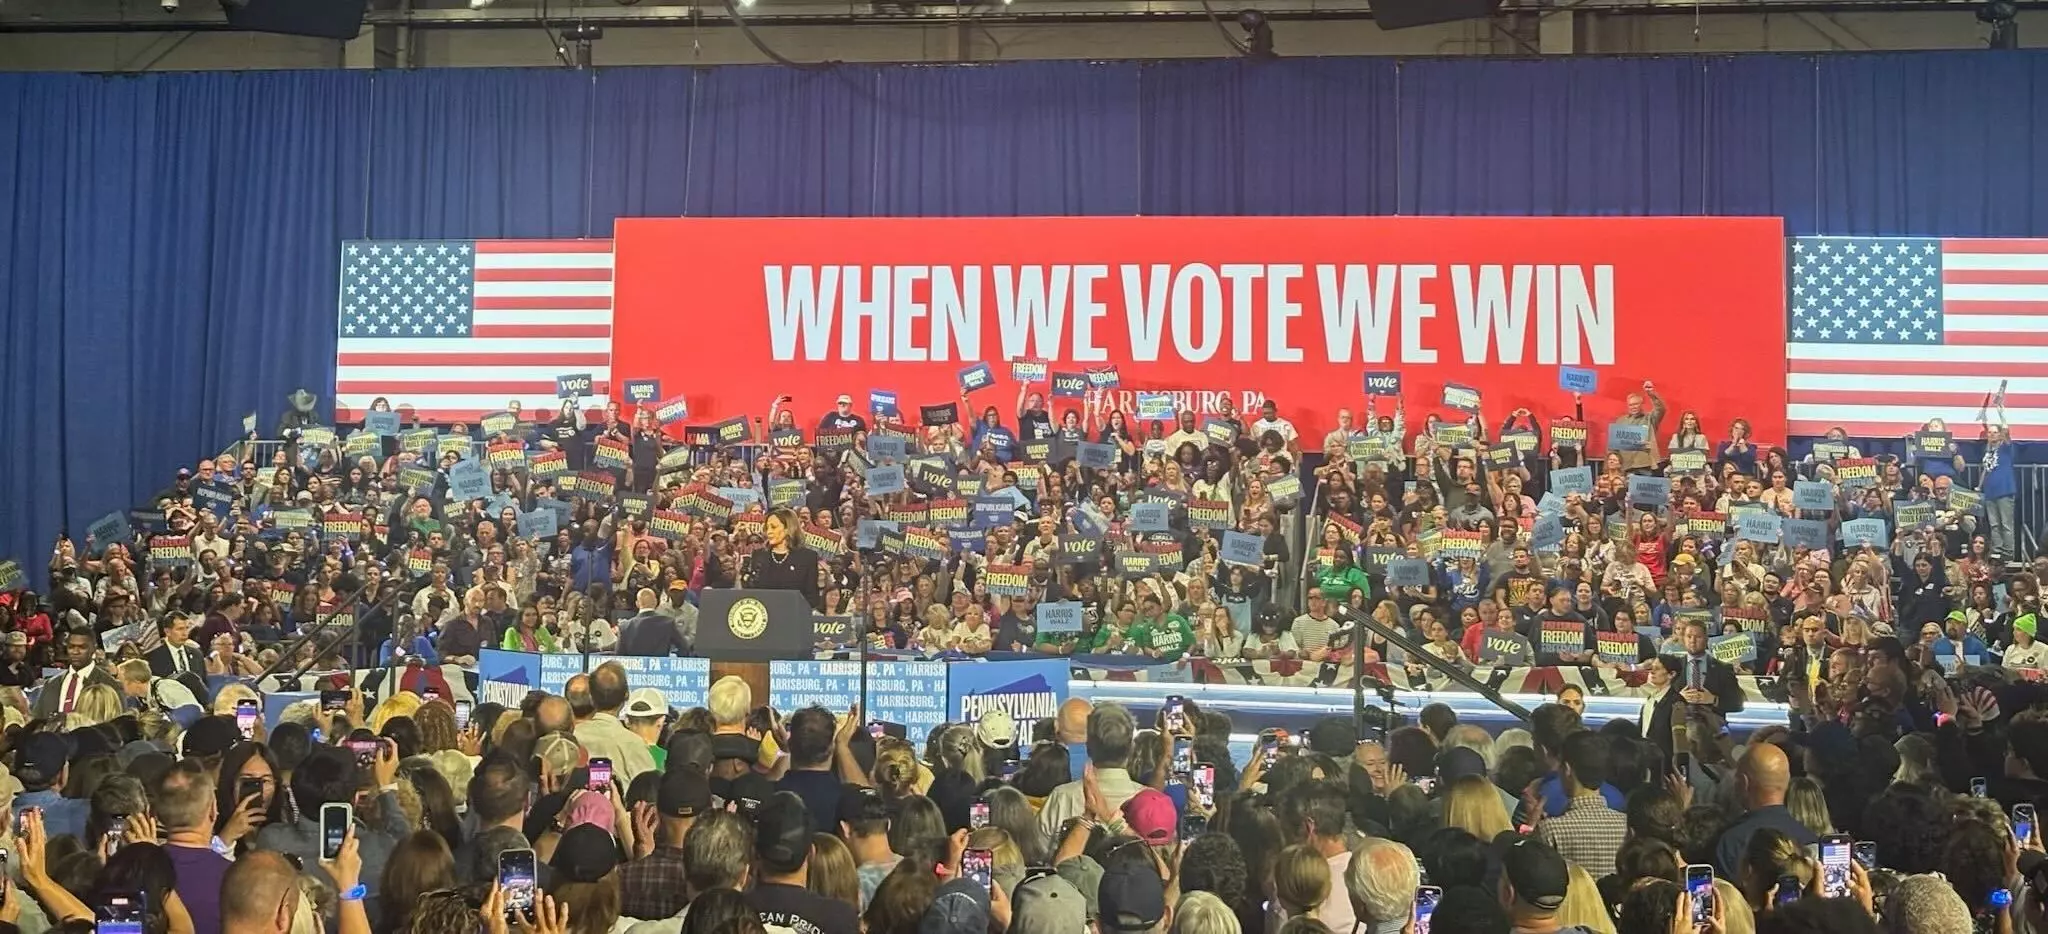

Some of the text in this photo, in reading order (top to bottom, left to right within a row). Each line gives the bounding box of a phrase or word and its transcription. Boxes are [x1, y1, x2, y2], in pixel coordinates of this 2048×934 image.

[763, 263, 1615, 364] WHEN WE VOTE WE WIN
[1013, 363, 1047, 375] FREEDOM
[1056, 378, 1084, 390] vote
[1368, 376, 1397, 388] vote
[1566, 372, 1590, 384] HARRIS
[561, 378, 589, 391] vote
[630, 385, 654, 393] HARRIS
[1242, 391, 1266, 414] PA
[656, 401, 687, 419] FREEDOM
[720, 423, 744, 437] HARRIS
[1551, 428, 1587, 440] FREEDOM
[1616, 430, 1642, 441] HARRIS
[773, 434, 800, 446] vote
[816, 435, 854, 448] FREEDOM
[1921, 437, 1945, 446] HARRIS
[596, 445, 629, 461] FREEDOM
[1026, 442, 1049, 454] HARRIS
[490, 450, 524, 461] FREEDOM
[533, 459, 568, 474] FREEDOM
[1838, 465, 1876, 478] FREEDOM
[923, 470, 952, 488] vote
[958, 480, 980, 490] HARRIS
[1559, 474, 1584, 485] HARRIS
[576, 478, 614, 495] FREEDOM
[1636, 482, 1663, 493] HARRIS
[1800, 486, 1826, 498] HARRIS
[623, 498, 647, 508] HARRIS
[695, 496, 730, 518] FREEDOM
[976, 503, 1013, 512] REPUBLICANS
[890, 511, 926, 524] FREEDOM
[930, 507, 967, 520] FREEDOM
[1188, 507, 1227, 520] FREEDOM
[324, 520, 361, 533] FREEDOM
[651, 517, 690, 534] FREEDOM
[1688, 519, 1726, 532] FREEDOM
[1746, 519, 1772, 530] HARRIS
[1850, 524, 1878, 534] HARRIS
[905, 534, 940, 550] FREEDOM
[1064, 538, 1096, 553] vote
[1442, 538, 1481, 550] FREEDOM
[150, 546, 190, 558] FREEDOM
[1159, 551, 1182, 565] EDOM
[1123, 558, 1150, 566] HARRIS
[987, 573, 1027, 587] FREEDOM
[1046, 609, 1073, 618] HARRIS
[813, 620, 846, 635] vote
[1152, 633, 1182, 647] HARRIS
[1541, 630, 1583, 644] FREEDOM
[1486, 636, 1521, 654] vote
[1597, 642, 1638, 656] FREEDOM
[568, 656, 580, 668] PA
[650, 659, 660, 671] PA
[797, 664, 810, 675] PA
[883, 665, 896, 676] PA
[676, 676, 687, 686] PA
[826, 680, 838, 690] PA
[912, 680, 923, 691] PA
[771, 694, 781, 706] PA
[876, 696, 939, 709] HARRISBURG,
[882, 711, 894, 721] PA
[912, 727, 923, 738] PA
